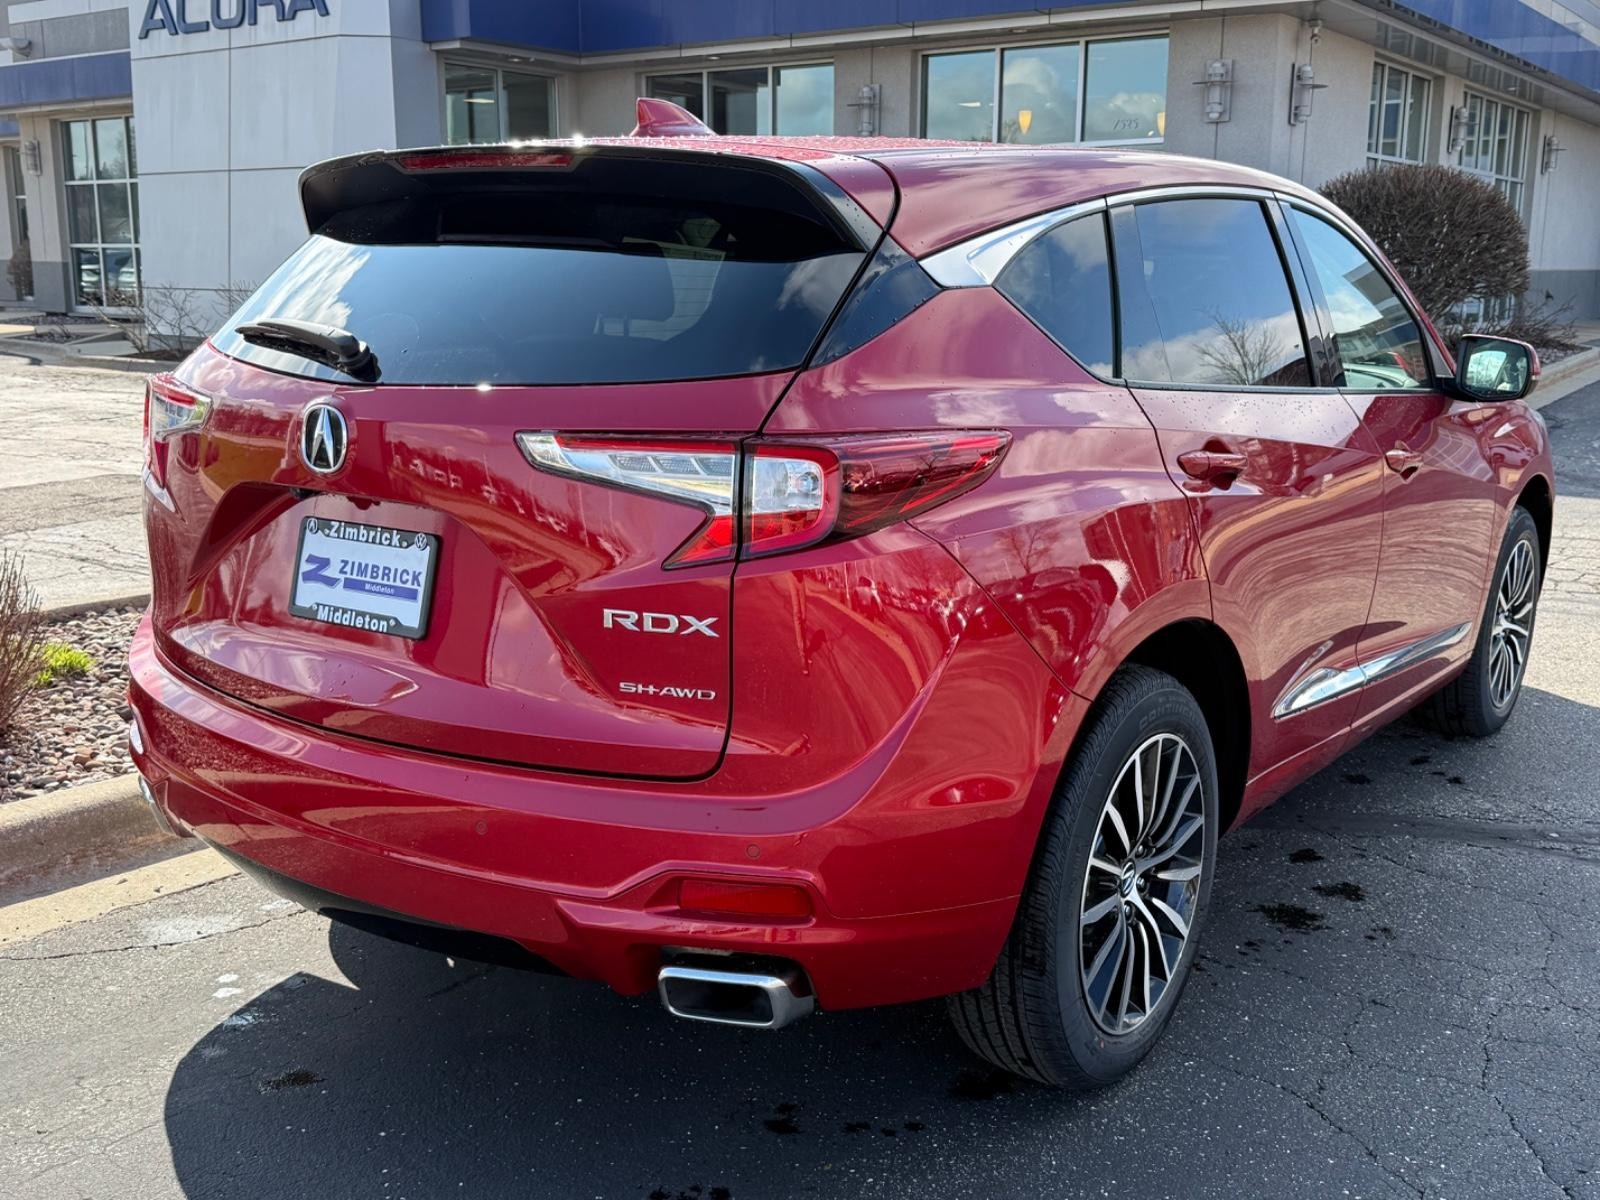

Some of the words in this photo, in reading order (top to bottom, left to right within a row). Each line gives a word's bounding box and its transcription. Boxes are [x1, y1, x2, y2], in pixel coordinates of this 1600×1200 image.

[329, 521, 401, 547] Zimbrick
[338, 559, 423, 587] ZIMBRICK
[365, 583, 395, 595] Middleton
[317, 604, 388, 632] Middleton
[603, 608, 720, 638] RDX
